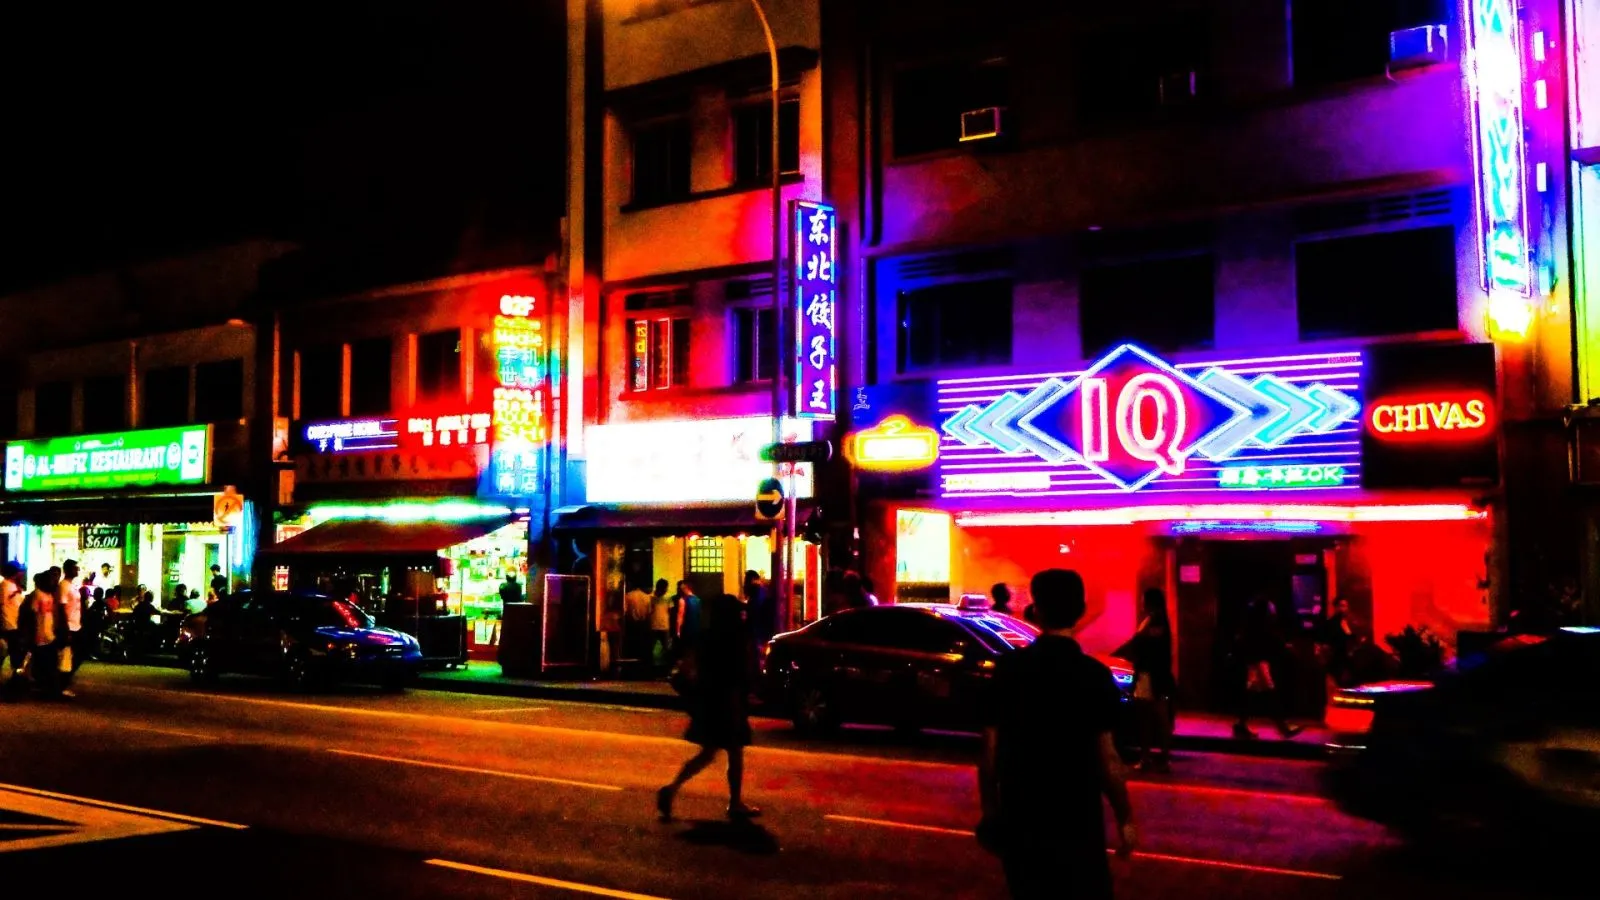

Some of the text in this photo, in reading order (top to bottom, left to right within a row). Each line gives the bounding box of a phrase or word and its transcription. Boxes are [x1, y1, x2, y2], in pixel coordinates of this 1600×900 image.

[806, 208, 833, 410] 东北饺子王
[1080, 372, 1186, 476] IQ
[1371, 398, 1487, 434] CHIVAS
[90, 445, 168, 473] RESTAURANT
[86, 534, 119, 548] $6.00
